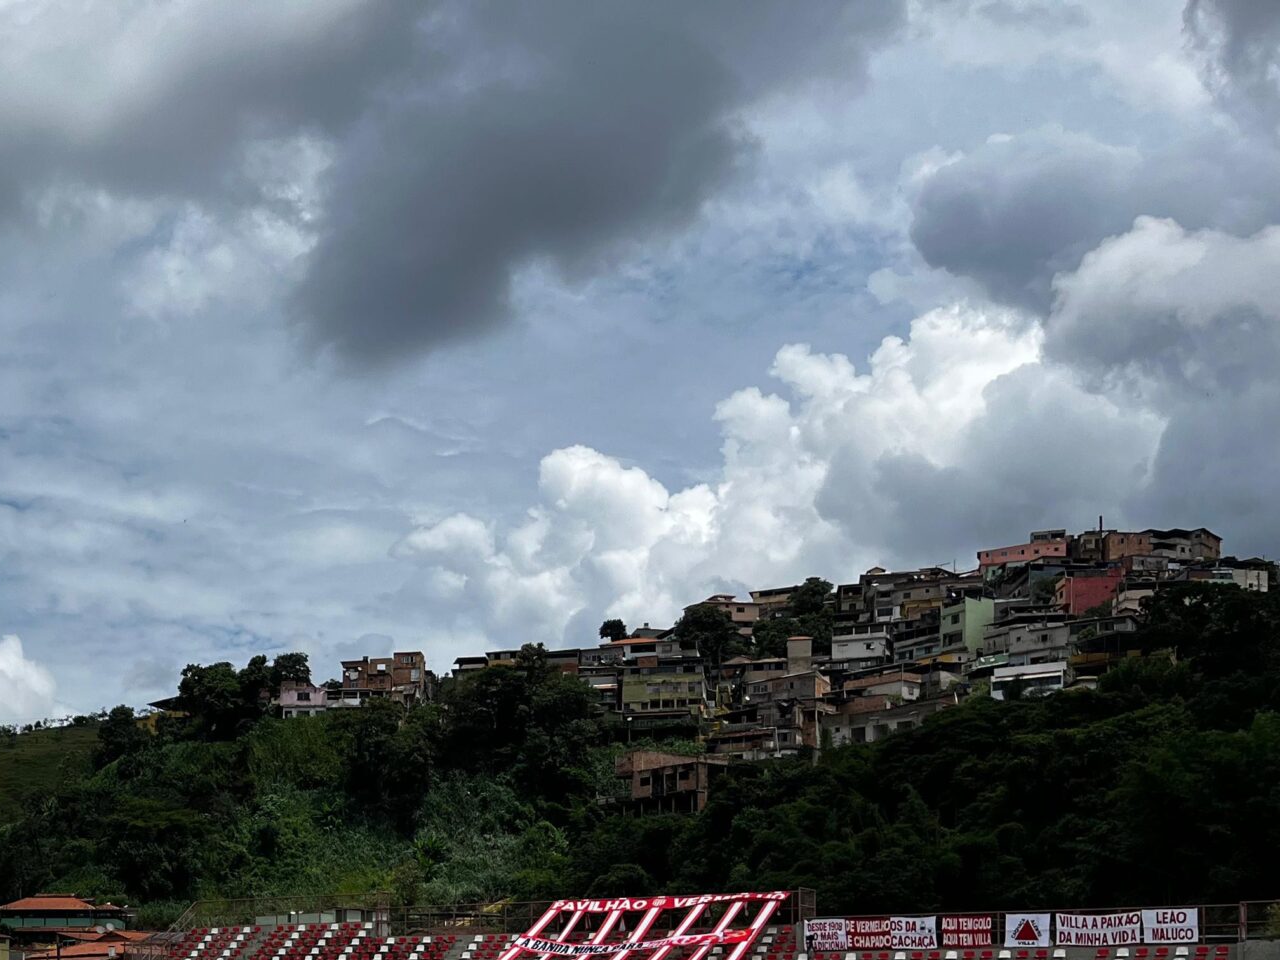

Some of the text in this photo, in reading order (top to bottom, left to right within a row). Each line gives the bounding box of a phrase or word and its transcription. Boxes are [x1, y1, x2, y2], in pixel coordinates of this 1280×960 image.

[807, 921, 843, 932] DESDE 1908
[846, 919, 891, 933] DE VERMELHO
[890, 920, 917, 932] OS DA
[942, 917, 992, 930] AQUI TEM GOLO
[1059, 915, 1088, 929] VILLA
[1091, 917, 1098, 930] A
[813, 932, 839, 941] O MAIS
[847, 933, 891, 948] E CHAPADO
[942, 933, 992, 945] AQUI TEM VILLA
[1059, 929, 1137, 945] DA MINHA VIDA
[1152, 927, 1194, 941] MALUCO
[521, 938, 531, 947] A
[531, 940, 570, 954] BANDA
[570, 945, 608, 954] NUNCA
[891, 934, 935, 949] CACHAÇA
